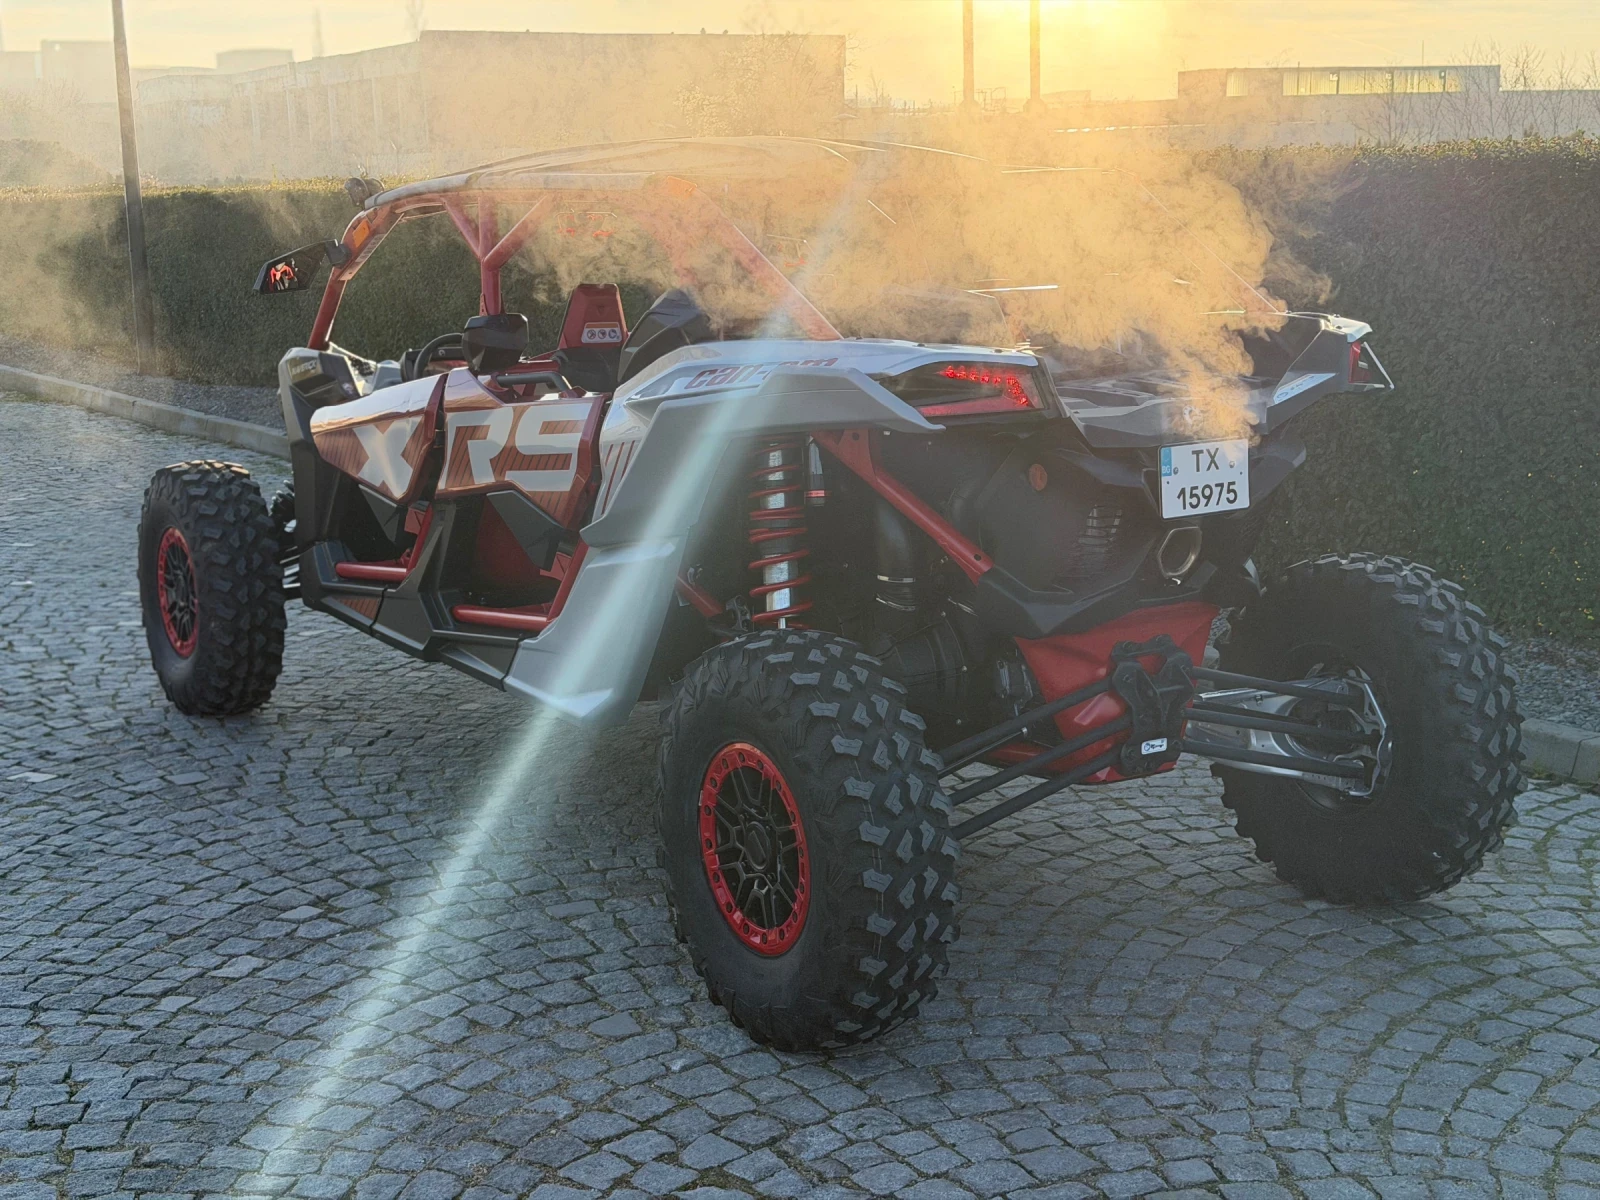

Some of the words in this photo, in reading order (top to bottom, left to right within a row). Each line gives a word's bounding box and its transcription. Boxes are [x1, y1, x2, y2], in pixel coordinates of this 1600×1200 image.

[352, 402, 594, 498] XRS
[1191, 447, 1220, 473] TX
[1176, 481, 1238, 510] 15975
